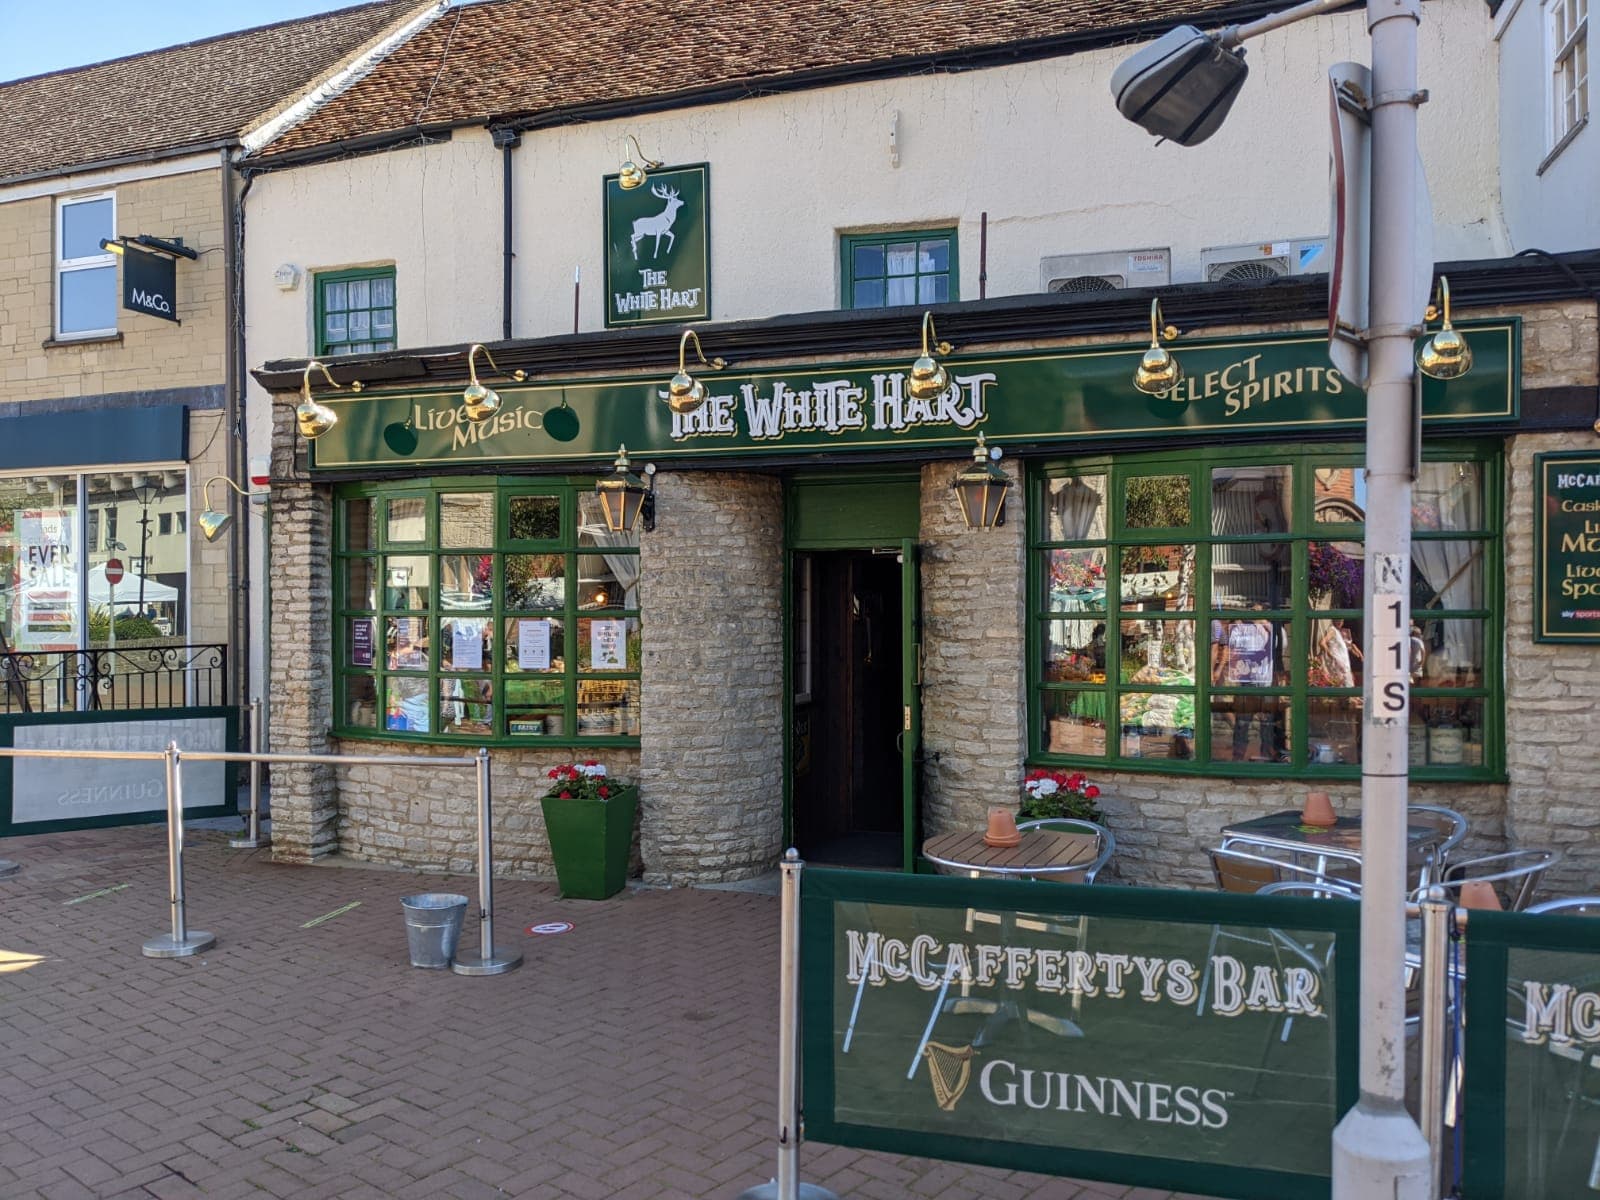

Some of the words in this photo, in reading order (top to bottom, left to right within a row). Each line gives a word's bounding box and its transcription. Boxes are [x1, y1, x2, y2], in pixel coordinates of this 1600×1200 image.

[131, 287, 171, 314] M&Co.
[639, 268, 667, 288] THE
[615, 291, 659, 315] WHITE
[660, 287, 702, 313] HART
[1153, 354, 1262, 402] ELECT
[1225, 367, 1343, 417] SPIRITS
[452, 406, 544, 451] Music
[739, 379, 868, 440] WHITE
[870, 372, 998, 434] HART
[28, 544, 70, 565] EVER
[28, 566, 70, 588] SALE
[1211, 955, 1323, 1018] BAR
[980, 1060, 1228, 1129] GUINNESS
